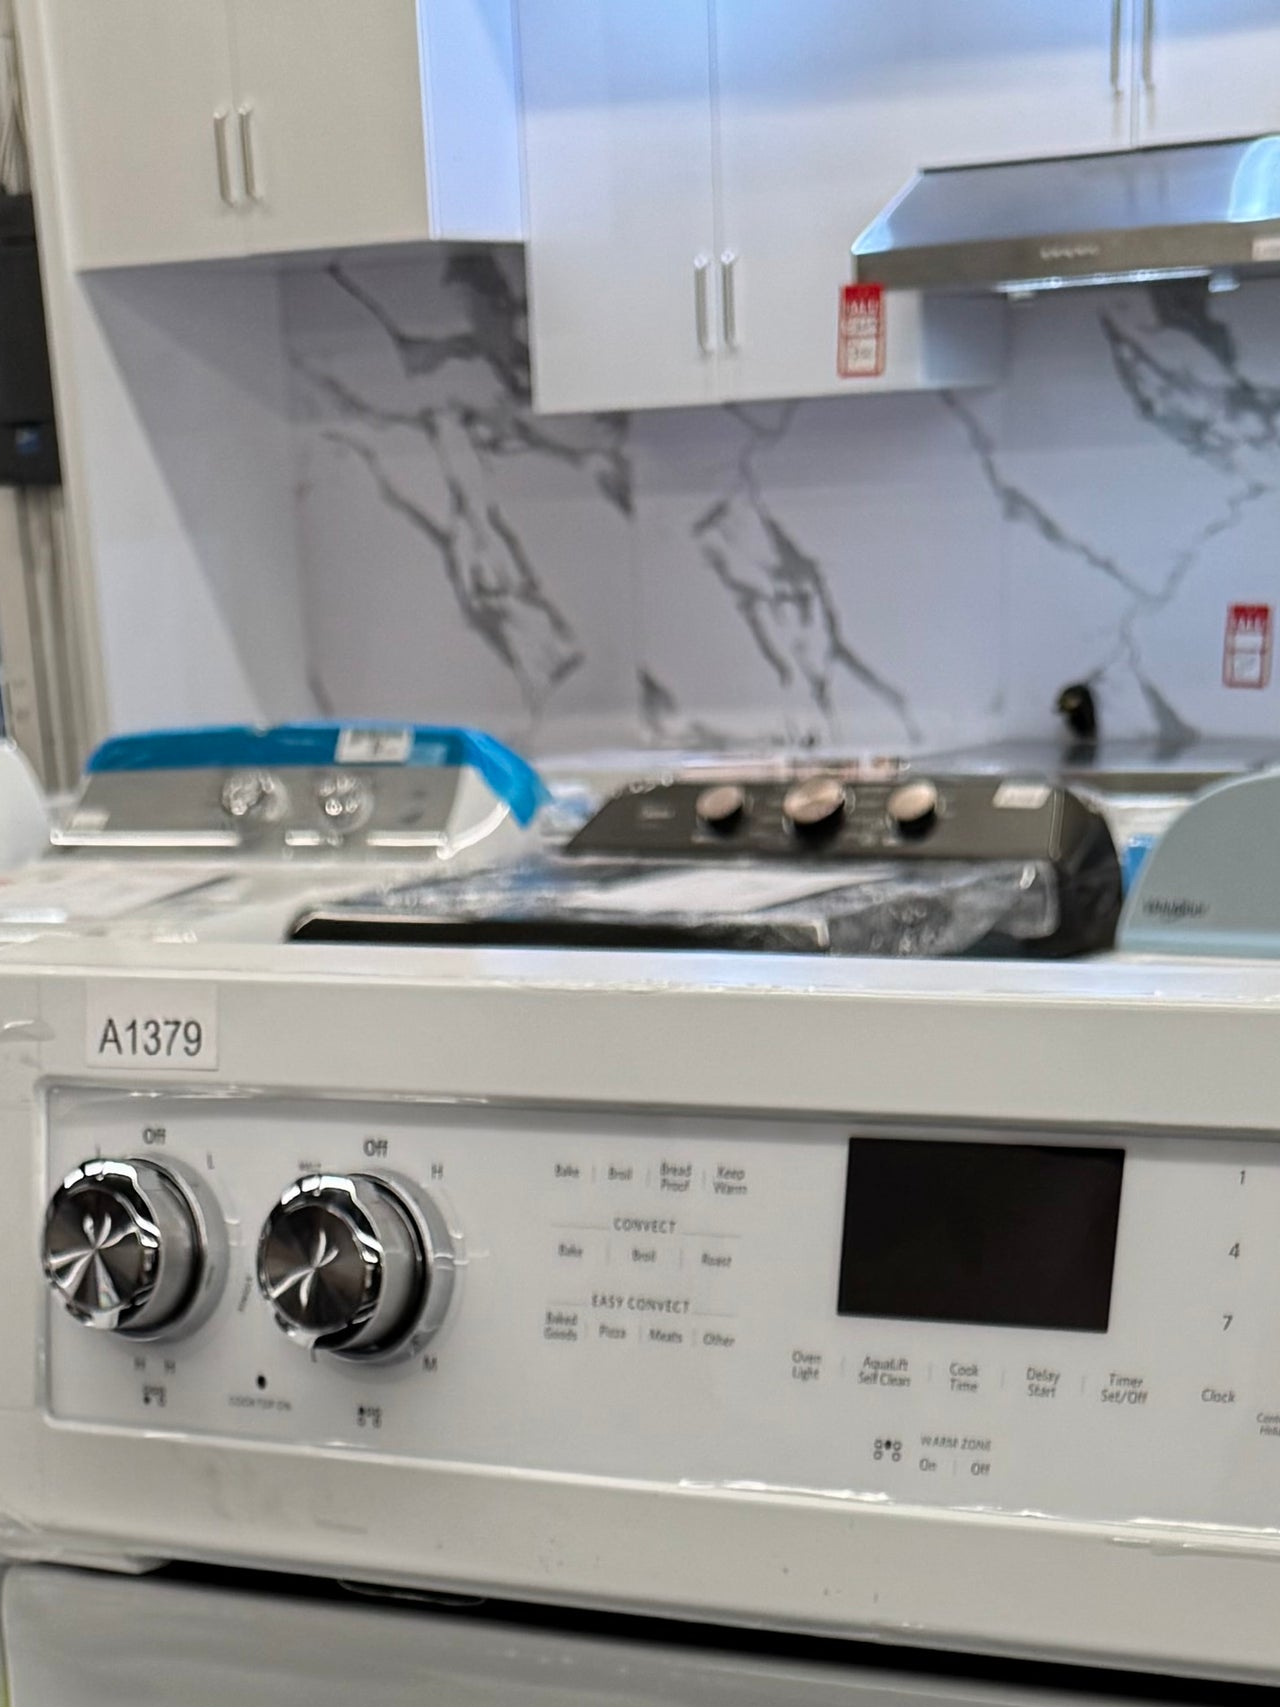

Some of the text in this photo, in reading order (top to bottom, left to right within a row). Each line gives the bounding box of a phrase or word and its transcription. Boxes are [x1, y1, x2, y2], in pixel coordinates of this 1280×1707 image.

[98, 1018, 203, 1057] A1379
[142, 1127, 166, 1145] Off
[363, 1138, 388, 1157] Off
[554, 1163, 579, 1178] Bake
[608, 1166, 633, 1181] Broil
[660, 1160, 692, 1178] Bread
[717, 1165, 745, 1181] Keep
[1239, 1171, 1246, 1185] 1
[613, 1217, 677, 1234] CONVECT
[559, 1243, 583, 1258] Bake
[632, 1248, 657, 1263] Broil
[1228, 1243, 1240, 1260] 4
[592, 1293, 690, 1314] EASY CONVECT
[1223, 1315, 1233, 1331] 7
[703, 1332, 736, 1347] Other
[792, 1351, 821, 1364] Oven
[863, 1356, 908, 1373] AquaLift
[792, 1365, 820, 1382] Light
[950, 1362, 978, 1377] Cook
[1026, 1367, 1060, 1386] Delay
[858, 1370, 911, 1388] Self Clean
[950, 1378, 978, 1393] Time
[1109, 1373, 1144, 1388] Timer
[1027, 1383, 1056, 1398] Start
[1100, 1388, 1148, 1405] Set/Off
[1201, 1388, 1236, 1404] Clock
[919, 1458, 938, 1473] On
[971, 1461, 990, 1476] Off
